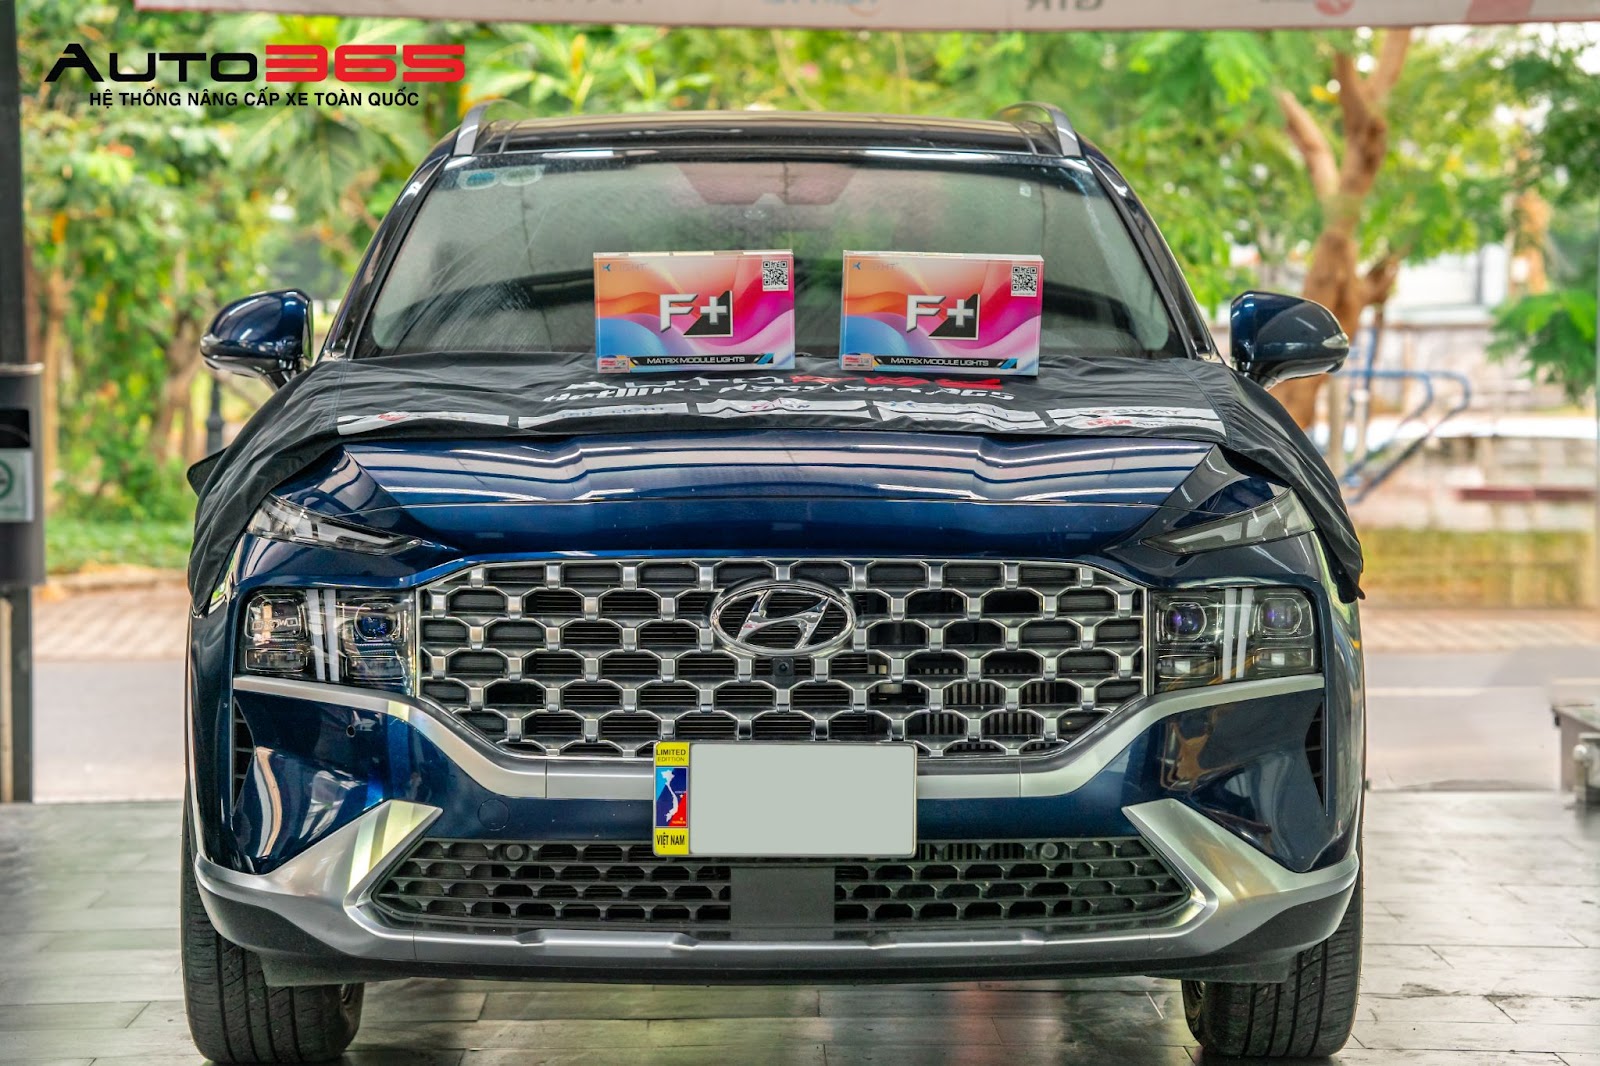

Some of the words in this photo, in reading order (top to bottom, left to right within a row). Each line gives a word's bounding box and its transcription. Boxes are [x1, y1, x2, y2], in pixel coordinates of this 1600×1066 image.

[660, 293, 730, 334] F+
[906, 294, 977, 334] F+
[647, 357, 679, 365] MATRIX
[890, 357, 922, 365] MATRIX
[923, 358, 959, 366] MODULE
[960, 359, 989, 367] LIGHTS
[656, 748, 687, 756] LIMITED
[656, 832, 669, 848] VIỆT
[670, 834, 685, 846] NAM
